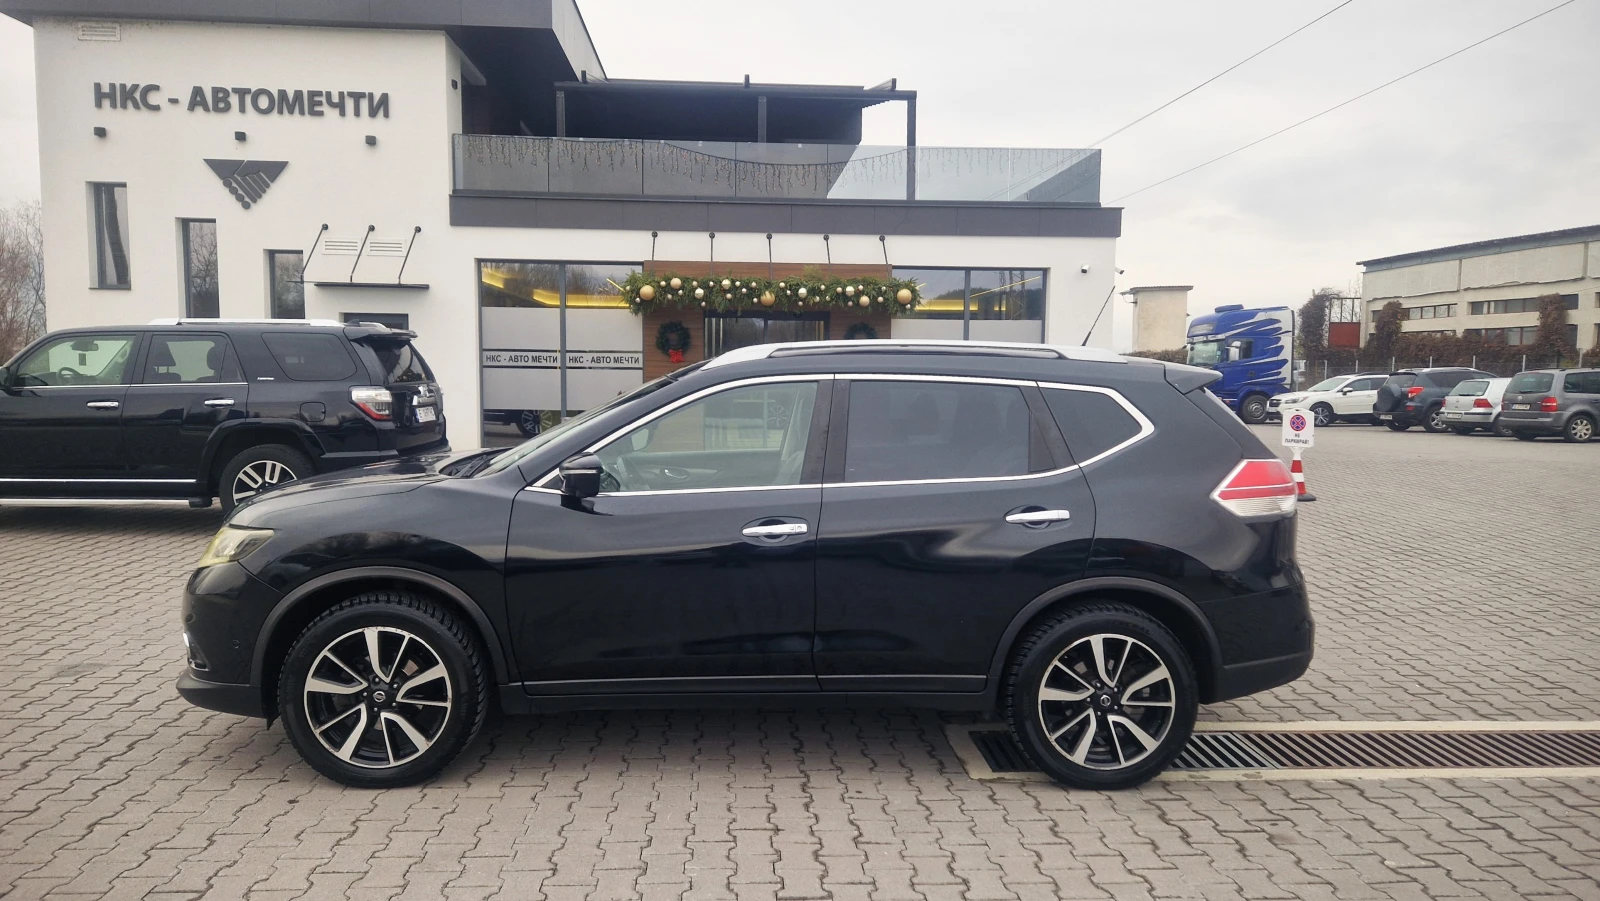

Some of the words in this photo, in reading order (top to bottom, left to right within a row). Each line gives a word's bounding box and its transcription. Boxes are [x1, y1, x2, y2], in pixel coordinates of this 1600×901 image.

[93, 81, 161, 111] НКС
[186, 85, 390, 119] АВТОМЕЧТИ
[485, 354, 502, 363] НКС
[508, 354, 530, 363] АВТО
[531, 355, 558, 364] МЕЧТИ
[568, 355, 585, 364] НКС
[590, 355, 612, 364] АВТО
[613, 356, 639, 364] МЕЧТИ
